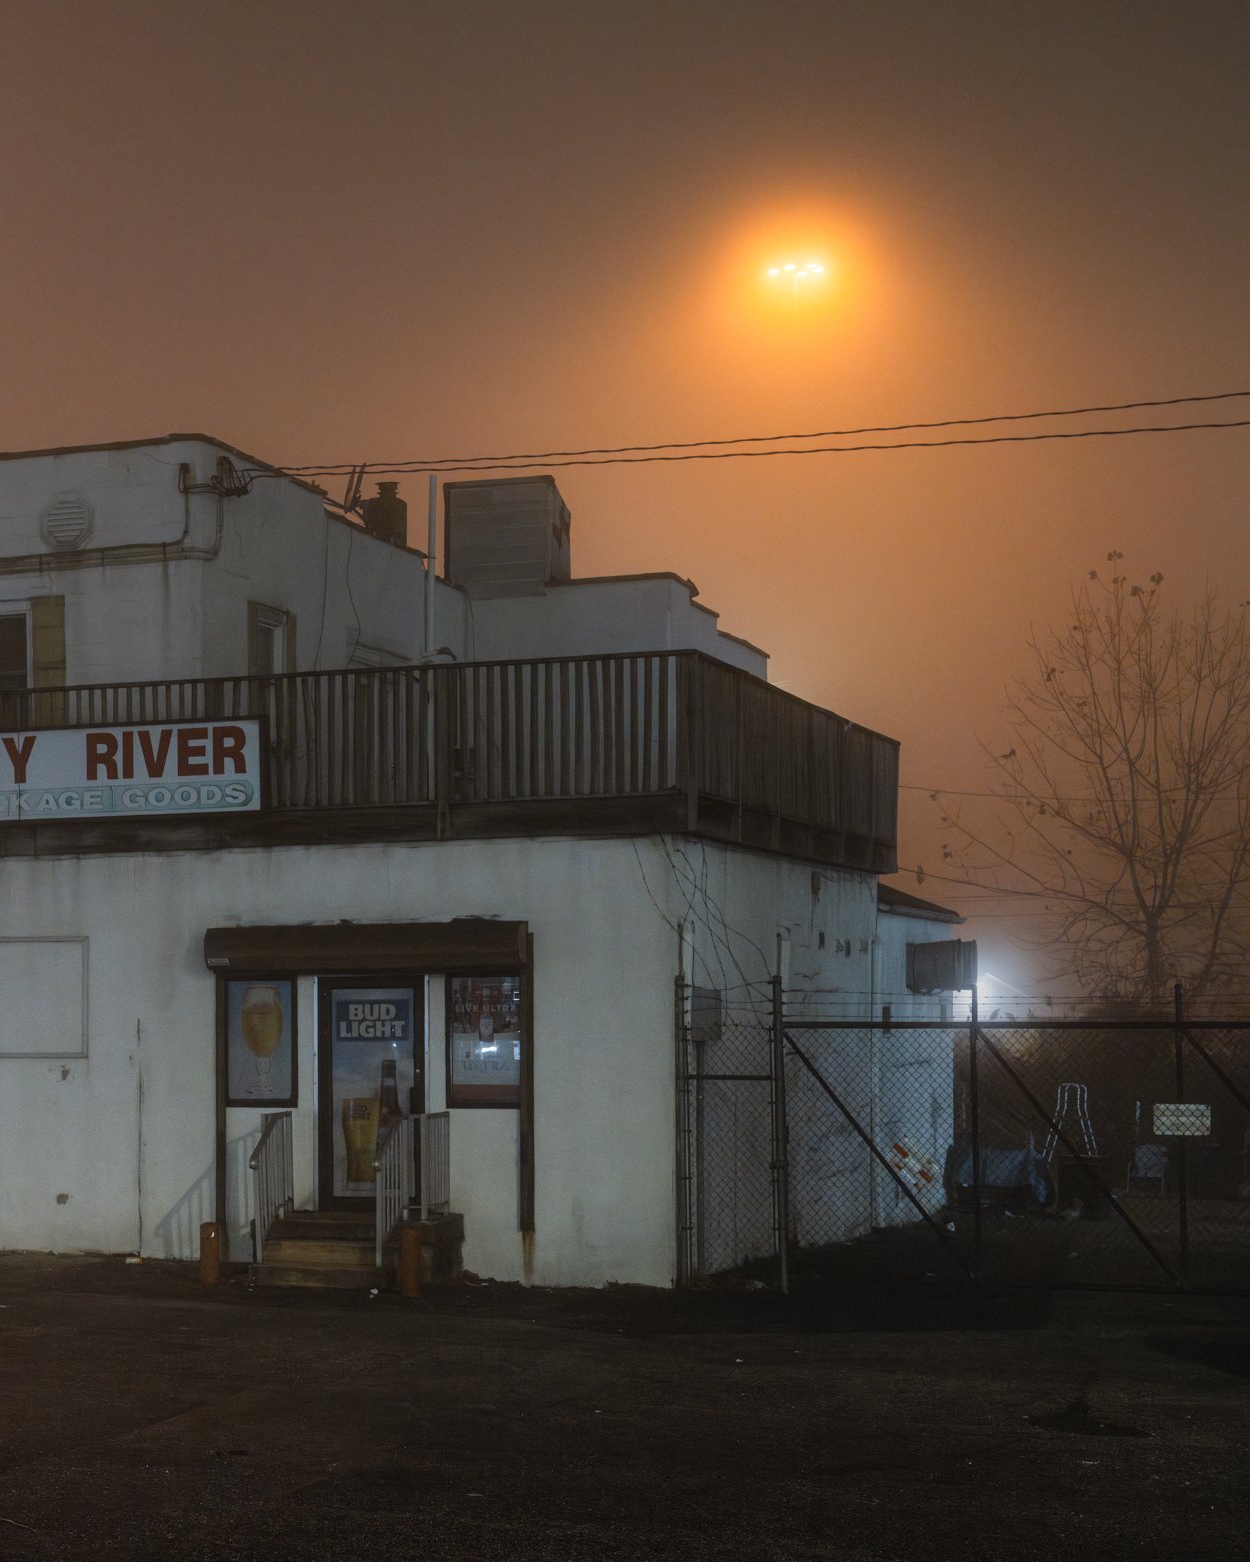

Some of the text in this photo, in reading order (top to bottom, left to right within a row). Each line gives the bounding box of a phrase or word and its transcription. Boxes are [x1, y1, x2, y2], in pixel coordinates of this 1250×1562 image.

[86, 725, 247, 780] RIVER
[121, 783, 249, 809] GOODS
[348, 1003, 397, 1021] BUD
[455, 1004, 479, 1014] LIVE
[339, 1020, 406, 1038] LIGHT
